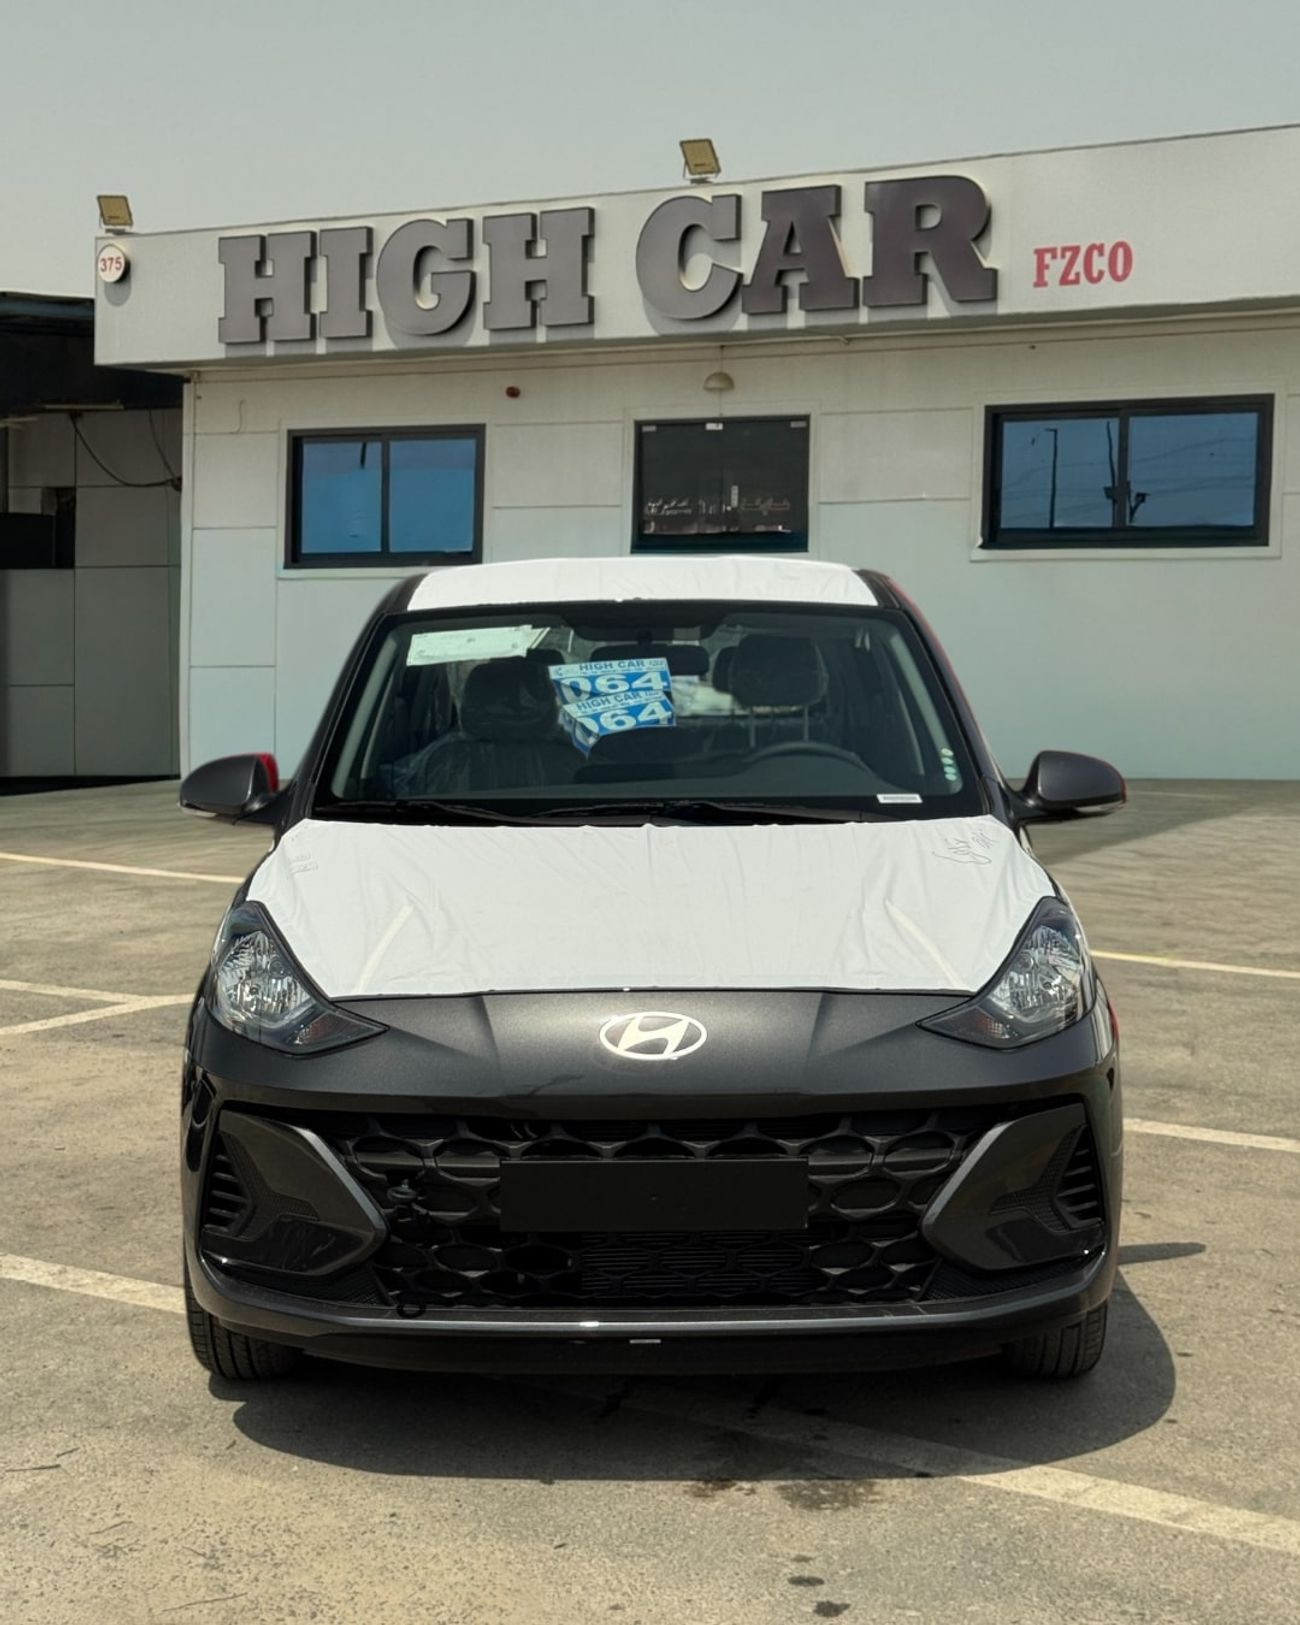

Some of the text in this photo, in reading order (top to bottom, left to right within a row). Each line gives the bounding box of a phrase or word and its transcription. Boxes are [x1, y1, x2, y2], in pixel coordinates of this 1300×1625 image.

[100, 256, 122, 272] 375
[218, 174, 1133, 345] HIGH CAR FZCO
[580, 662, 613, 671] HIGH
[618, 660, 645, 668] CAR
[561, 672, 667, 702] 064
[576, 697, 611, 710] HIGH
[614, 692, 642, 702] CAR
